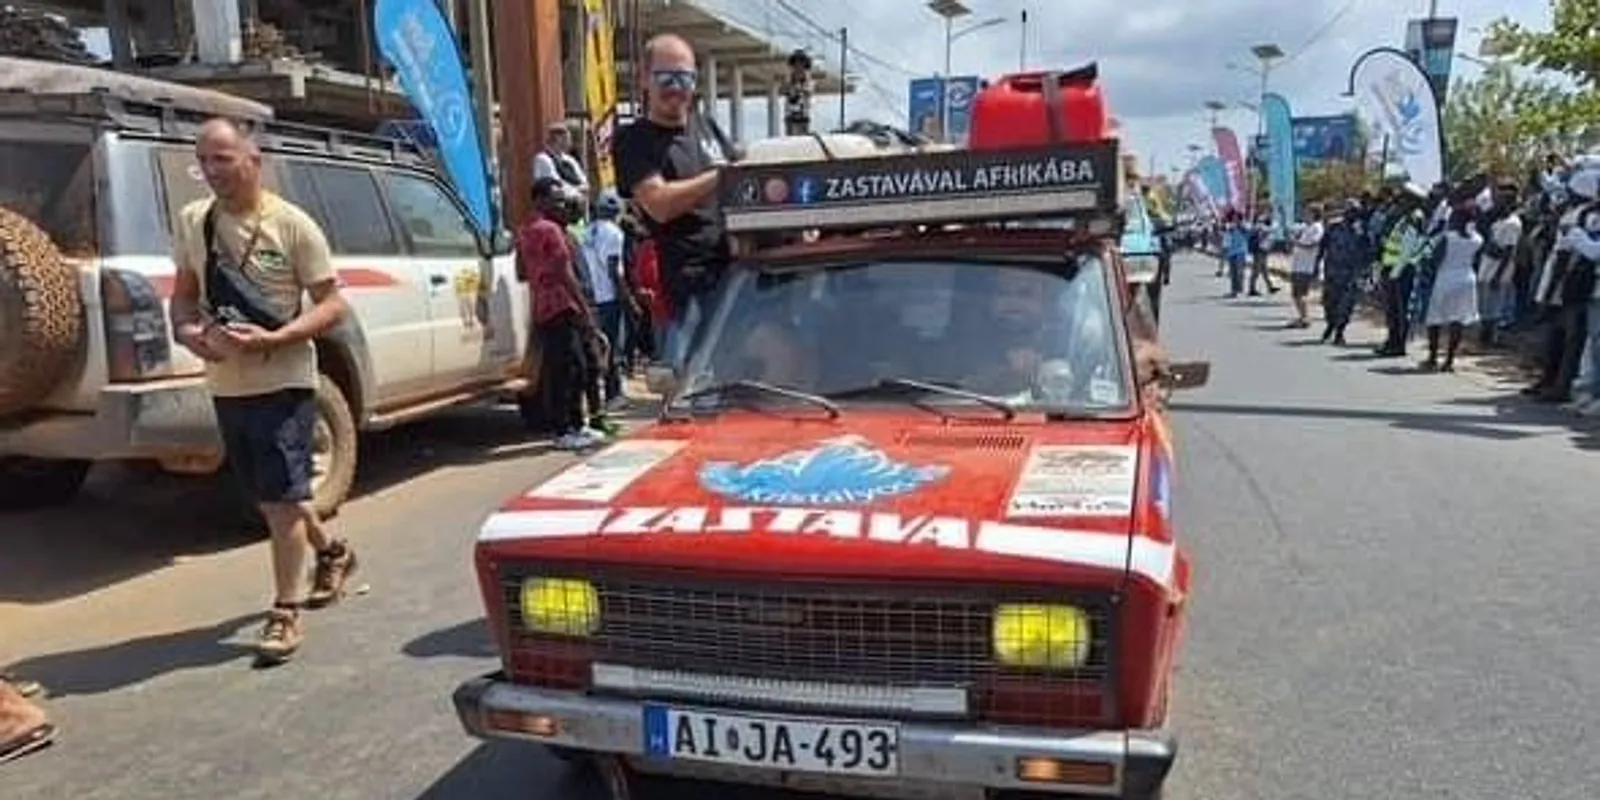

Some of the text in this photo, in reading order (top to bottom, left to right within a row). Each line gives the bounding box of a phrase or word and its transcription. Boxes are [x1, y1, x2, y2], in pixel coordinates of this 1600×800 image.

[826, 159, 1094, 198] ZASTAVÁVAL AFRIKÁBA
[601, 506, 969, 548] ZASTAVA
